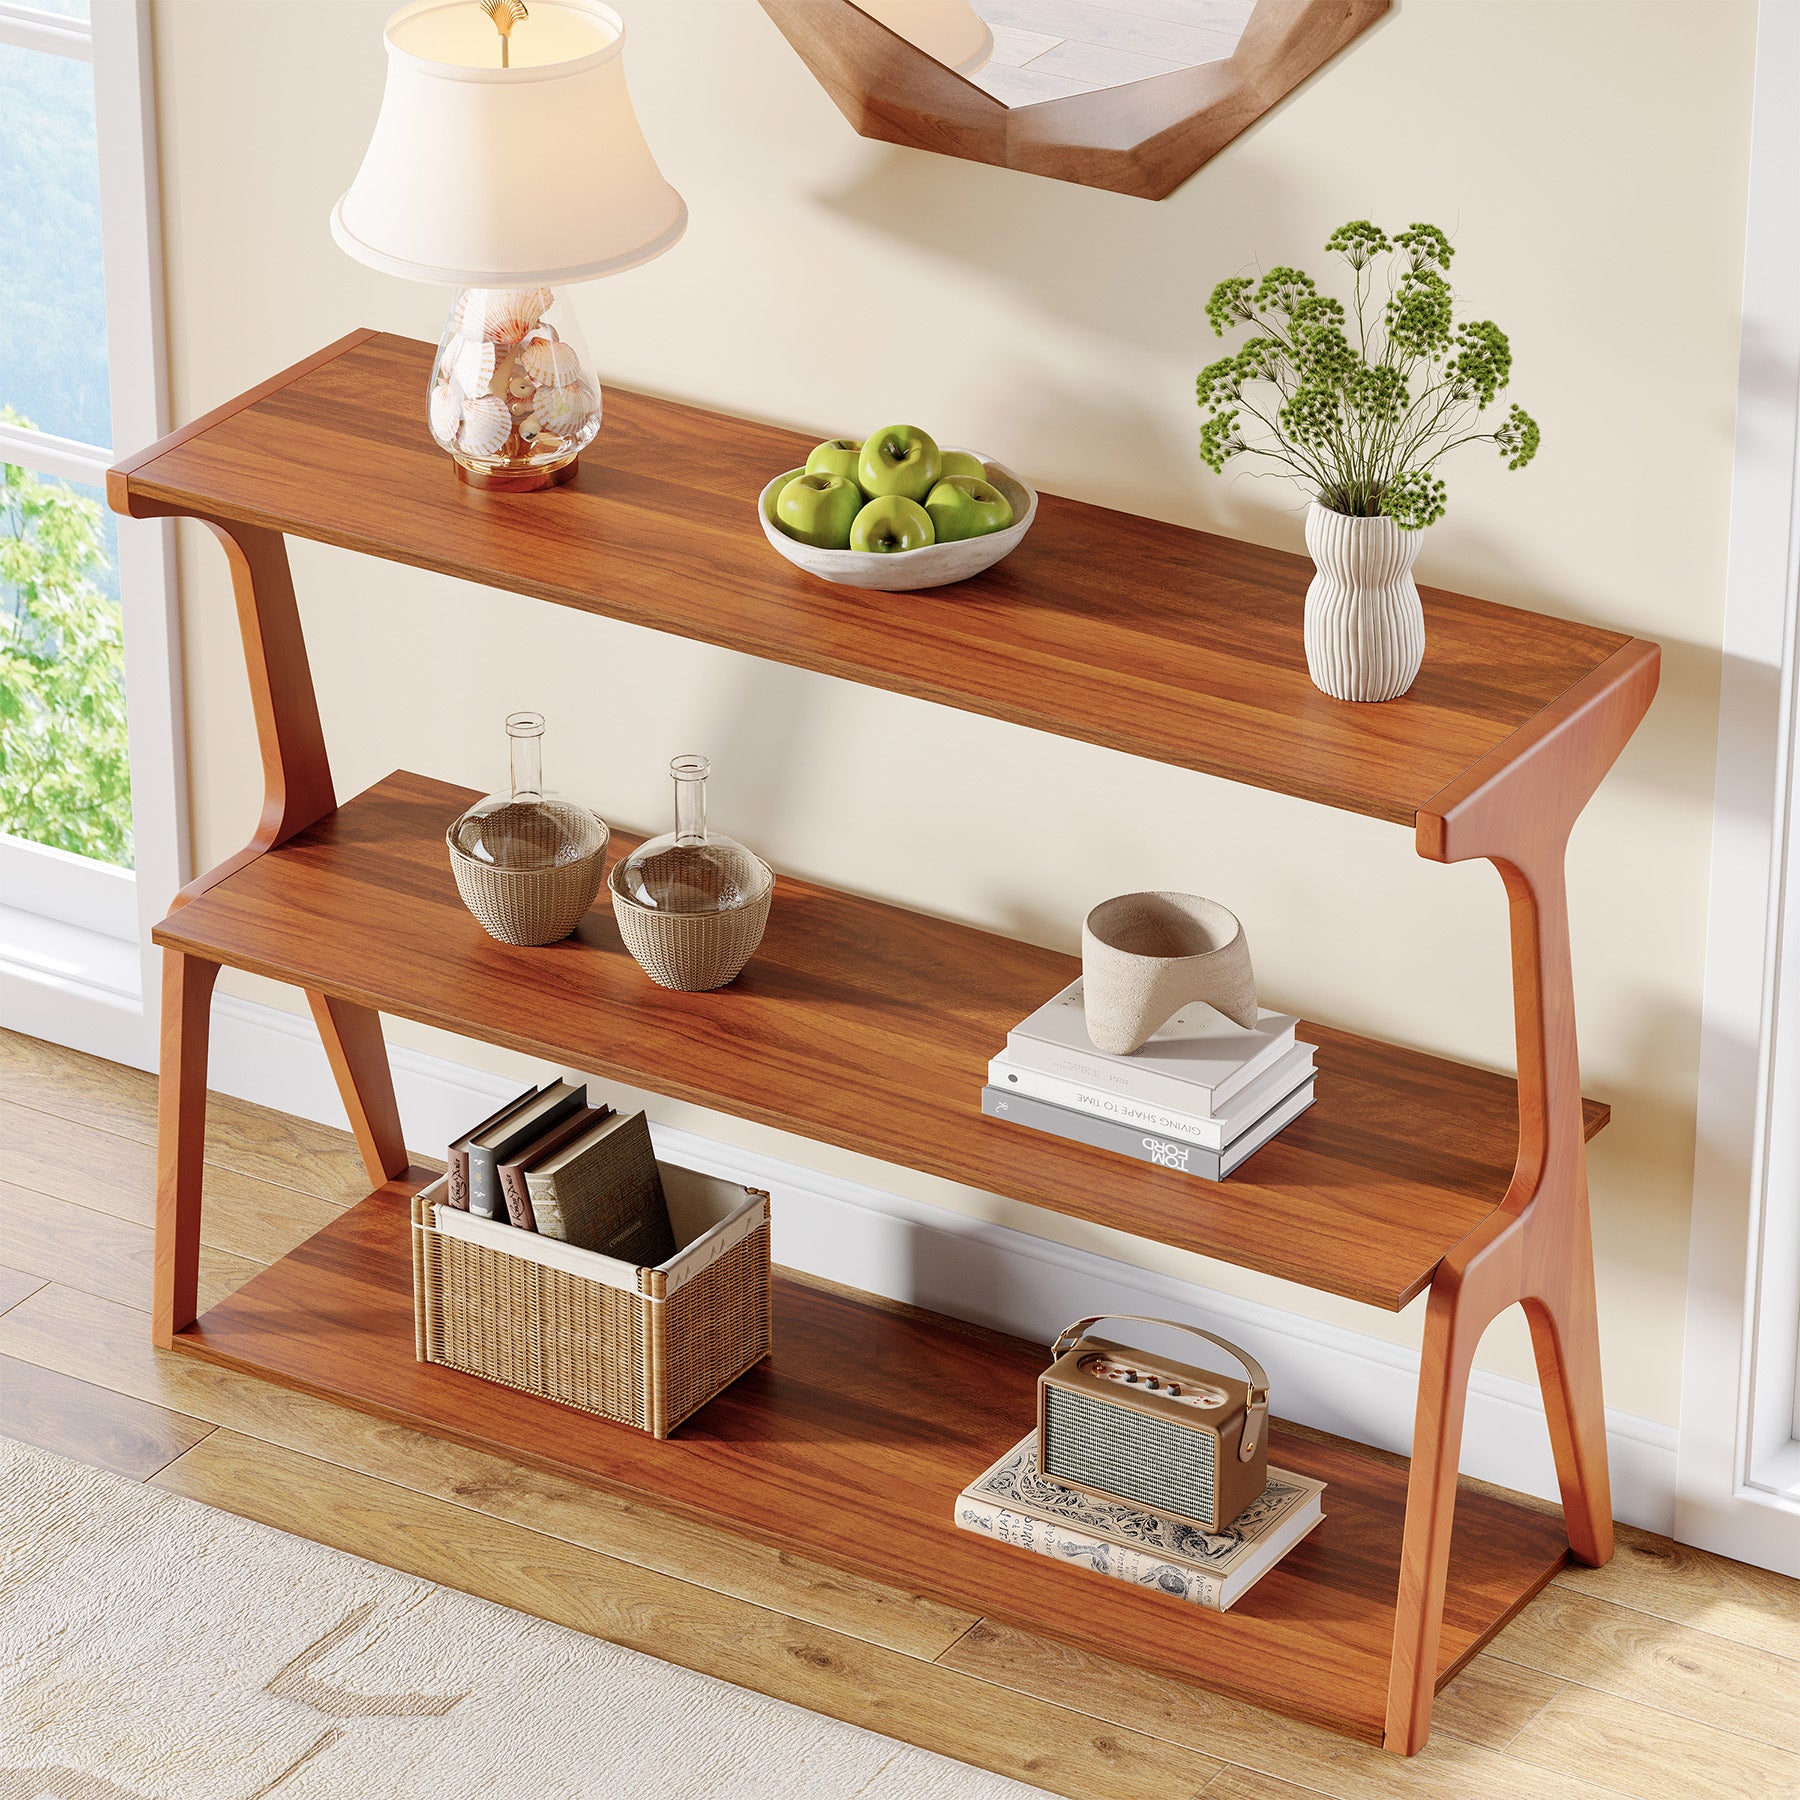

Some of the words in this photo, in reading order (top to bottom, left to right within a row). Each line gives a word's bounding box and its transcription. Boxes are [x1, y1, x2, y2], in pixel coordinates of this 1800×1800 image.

[1076, 1092, 1101, 1107] TIME
[1104, 1101, 1118, 1112] TO
[1122, 1106, 1156, 1123] SHAPE
[1159, 1117, 1201, 1136] GIVING
[1142, 1137, 1189, 1161] FORD
[1151, 1150, 1188, 1172] TOM
